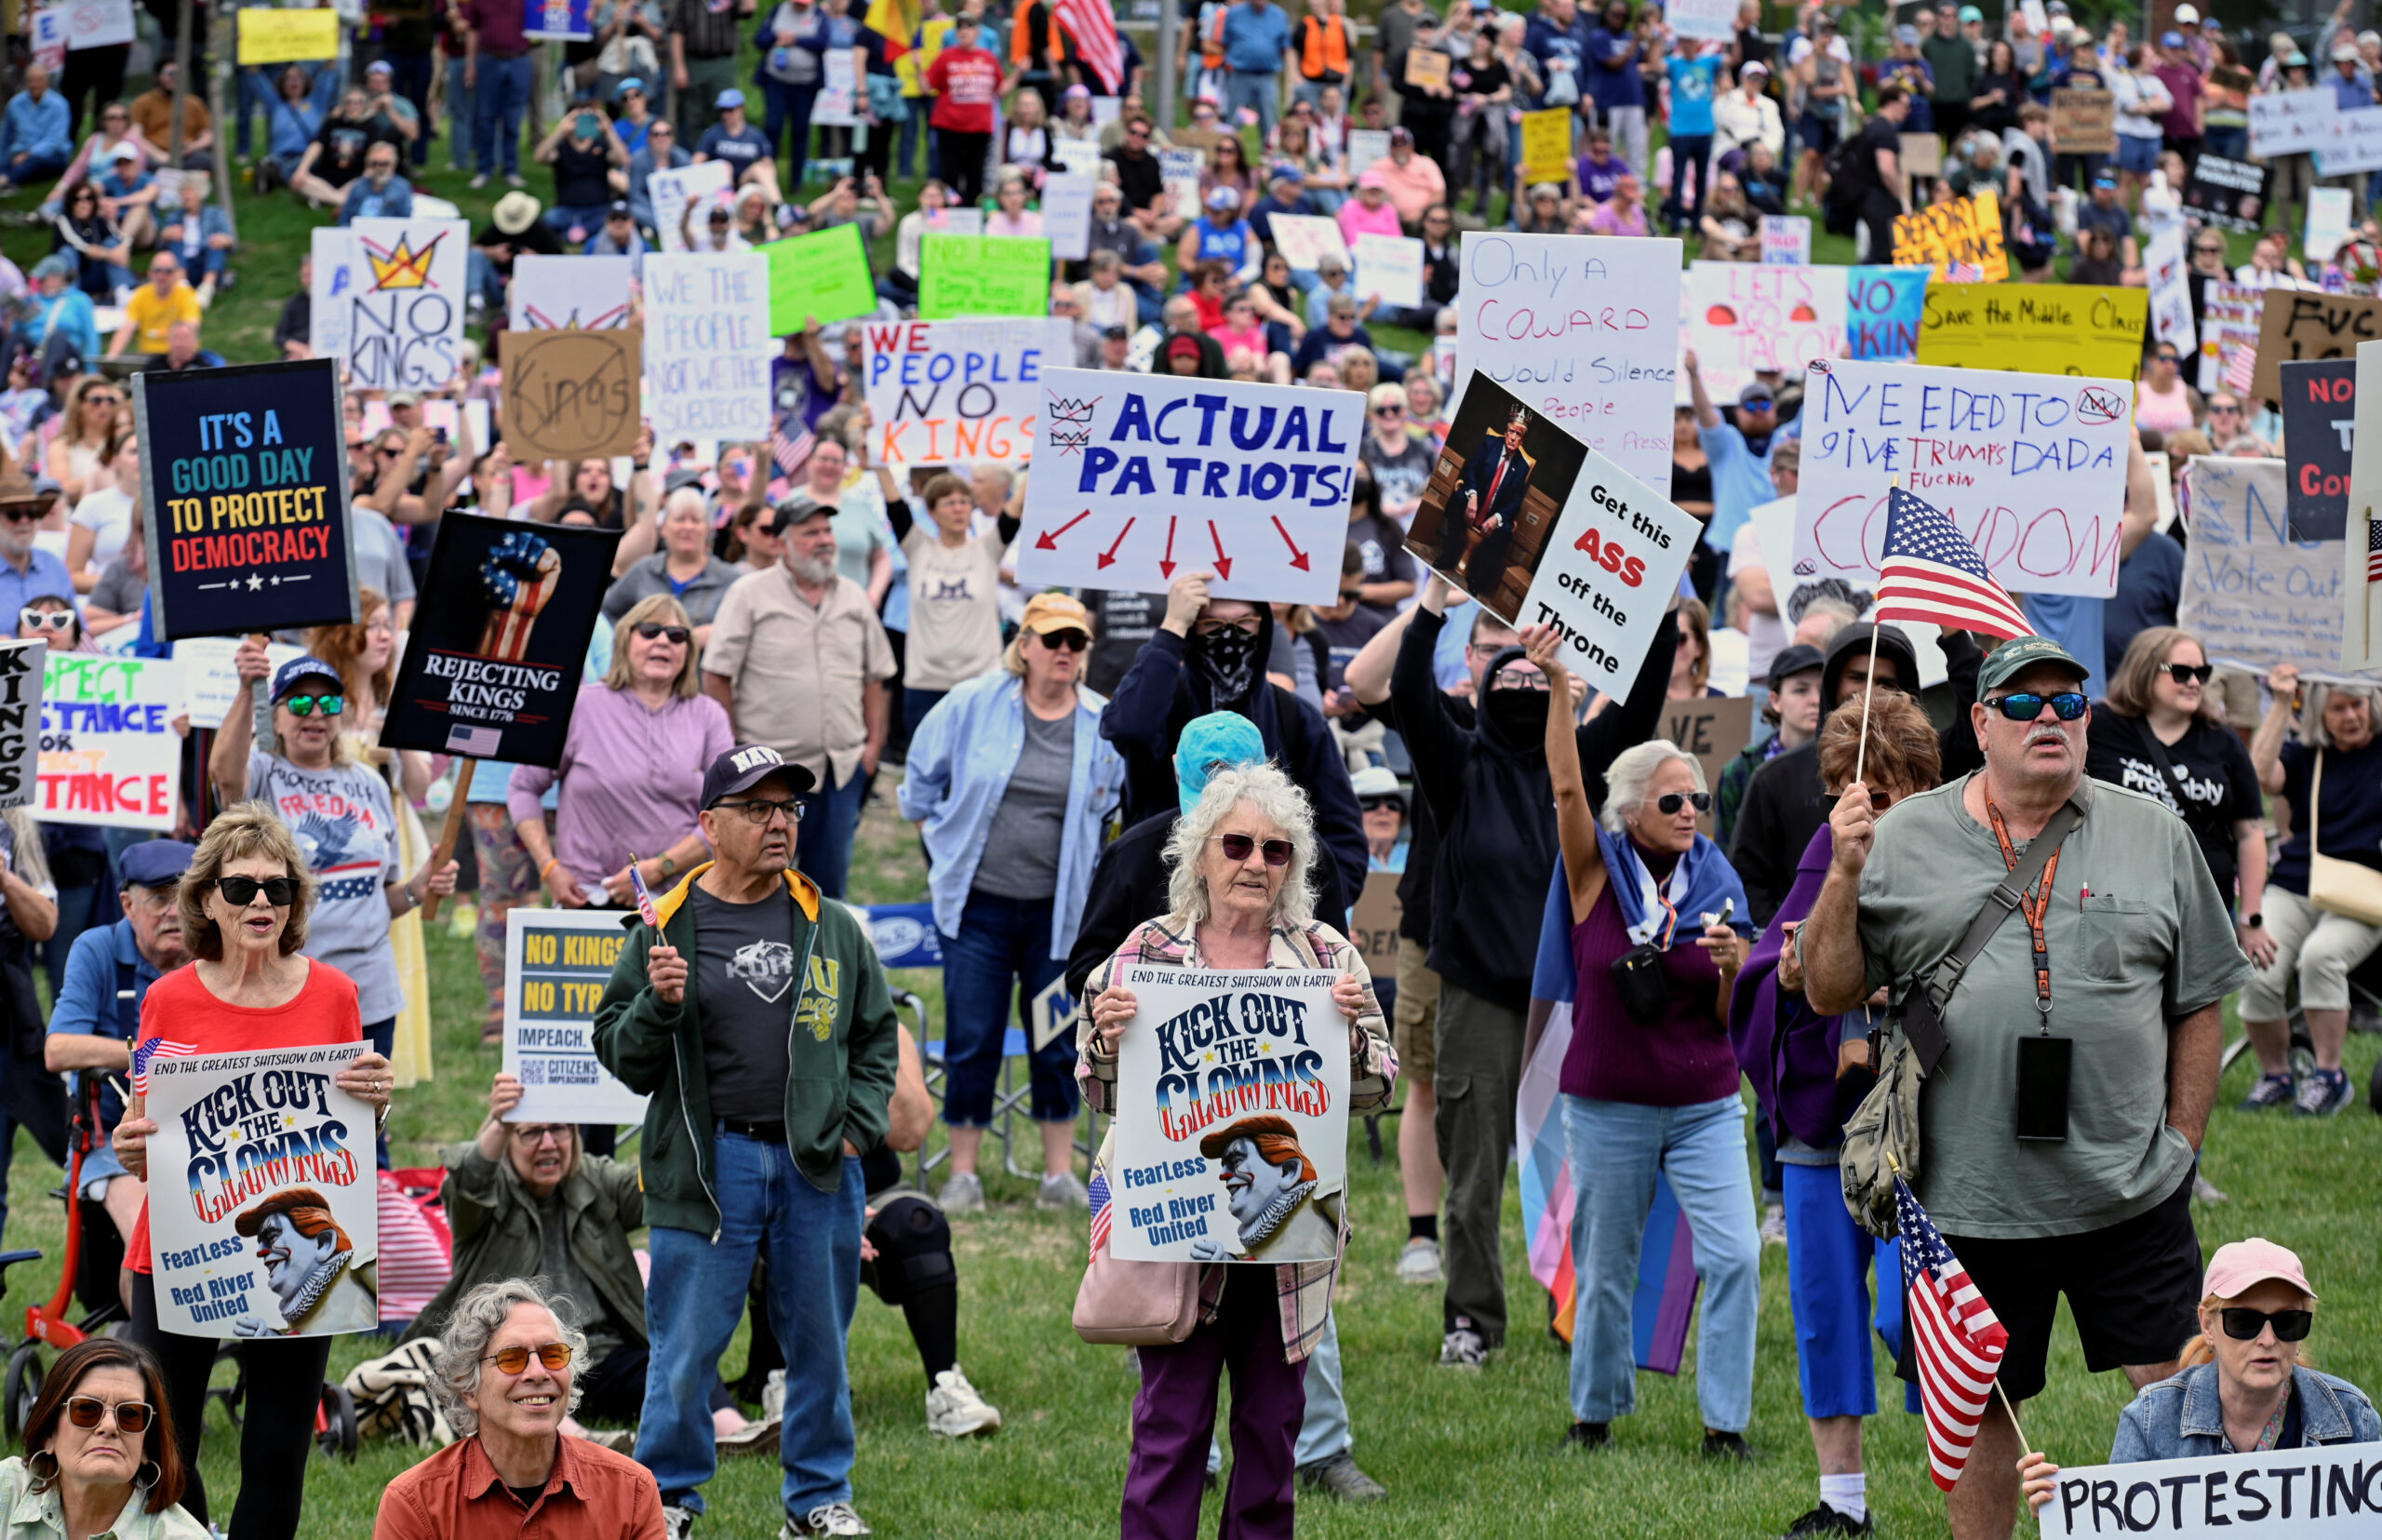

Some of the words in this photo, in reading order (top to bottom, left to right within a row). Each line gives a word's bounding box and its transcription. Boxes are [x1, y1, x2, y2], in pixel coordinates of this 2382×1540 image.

[650, 269, 694, 304] WE
[705, 266, 755, 304] THE
[1472, 237, 1568, 299] Only
[1585, 258, 1607, 279] A
[1730, 267, 1815, 301] LETS
[353, 294, 451, 336] NO
[1847, 279, 1895, 315] NO
[869, 323, 931, 353] WE
[350, 335, 456, 387] KINGS
[871, 349, 1042, 386] PEOPLE
[1591, 357, 1676, 383] Silence
[511, 354, 630, 441] Kings
[895, 382, 997, 421] NO
[1544, 397, 1616, 422] People
[1824, 372, 2005, 433] NEEDED
[2012, 392, 2070, 434] TO
[198, 410, 254, 451] IT'S
[263, 409, 283, 446] A
[881, 414, 1037, 462] KINGS
[1109, 392, 1347, 454] ACTUAL
[171, 453, 250, 494] GOOD
[259, 447, 314, 486] DAY
[1077, 446, 1352, 507] PATRIOTS!
[167, 498, 203, 533] TO
[209, 486, 327, 530] PROTECT
[1589, 484, 1629, 521] Get
[1631, 511, 1672, 550] this
[171, 525, 331, 572] DEMOCRACY
[1573, 528, 1646, 587] ASS
[1558, 572, 1591, 599] off
[1593, 593, 1626, 626] the
[1537, 601, 1620, 674] Throne
[423, 653, 560, 691] REJECTING
[447, 680, 527, 710] KINGS
[448, 703, 489, 719] SINCE
[489, 709, 515, 723] 1776
[1671, 714, 1716, 755] VE
[730, 746, 784, 774] NAVY
[526, 934, 556, 965] NO
[563, 935, 626, 967] KINGS
[524, 982, 555, 1012] NO
[562, 983, 609, 1014] TYR
[1131, 970, 1154, 984] END
[1157, 971, 1176, 984] THE
[1178, 973, 1228, 988] GREATEST
[1231, 975, 1283, 988] SHITSHOW
[1286, 975, 1300, 987] ON
[1304, 975, 1336, 987] EARTH!
[517, 1028, 587, 1048] IMPEACH.
[1155, 993, 1240, 1076] KICK
[1239, 992, 1310, 1047] OUT
[1214, 1037, 1258, 1065] THE
[154, 1063, 177, 1076] END
[180, 1061, 198, 1073] THE
[201, 1056, 250, 1072] GREATEST
[253, 1052, 307, 1068] SHITSHOW
[310, 1051, 326, 1065] ON
[328, 1048, 364, 1063] EARTH!
[547, 1060, 598, 1076] CITIZENS
[547, 1076, 600, 1086] IMPEACHMENT
[180, 1072, 264, 1160] KICK
[261, 1070, 333, 1118] OUT
[1156, 1050, 1331, 1143] CLOWNS
[239, 1111, 283, 1142] THE
[187, 1119, 358, 1225] CLOWNS
[1130, 1202, 1164, 1228] Red
[1168, 1193, 1215, 1220] River
[1147, 1215, 1209, 1247] United
[170, 1282, 205, 1307] Red
[208, 1270, 256, 1297] River
[189, 1294, 249, 1324] United
[2061, 1458, 2382, 1535] PROTESTING
